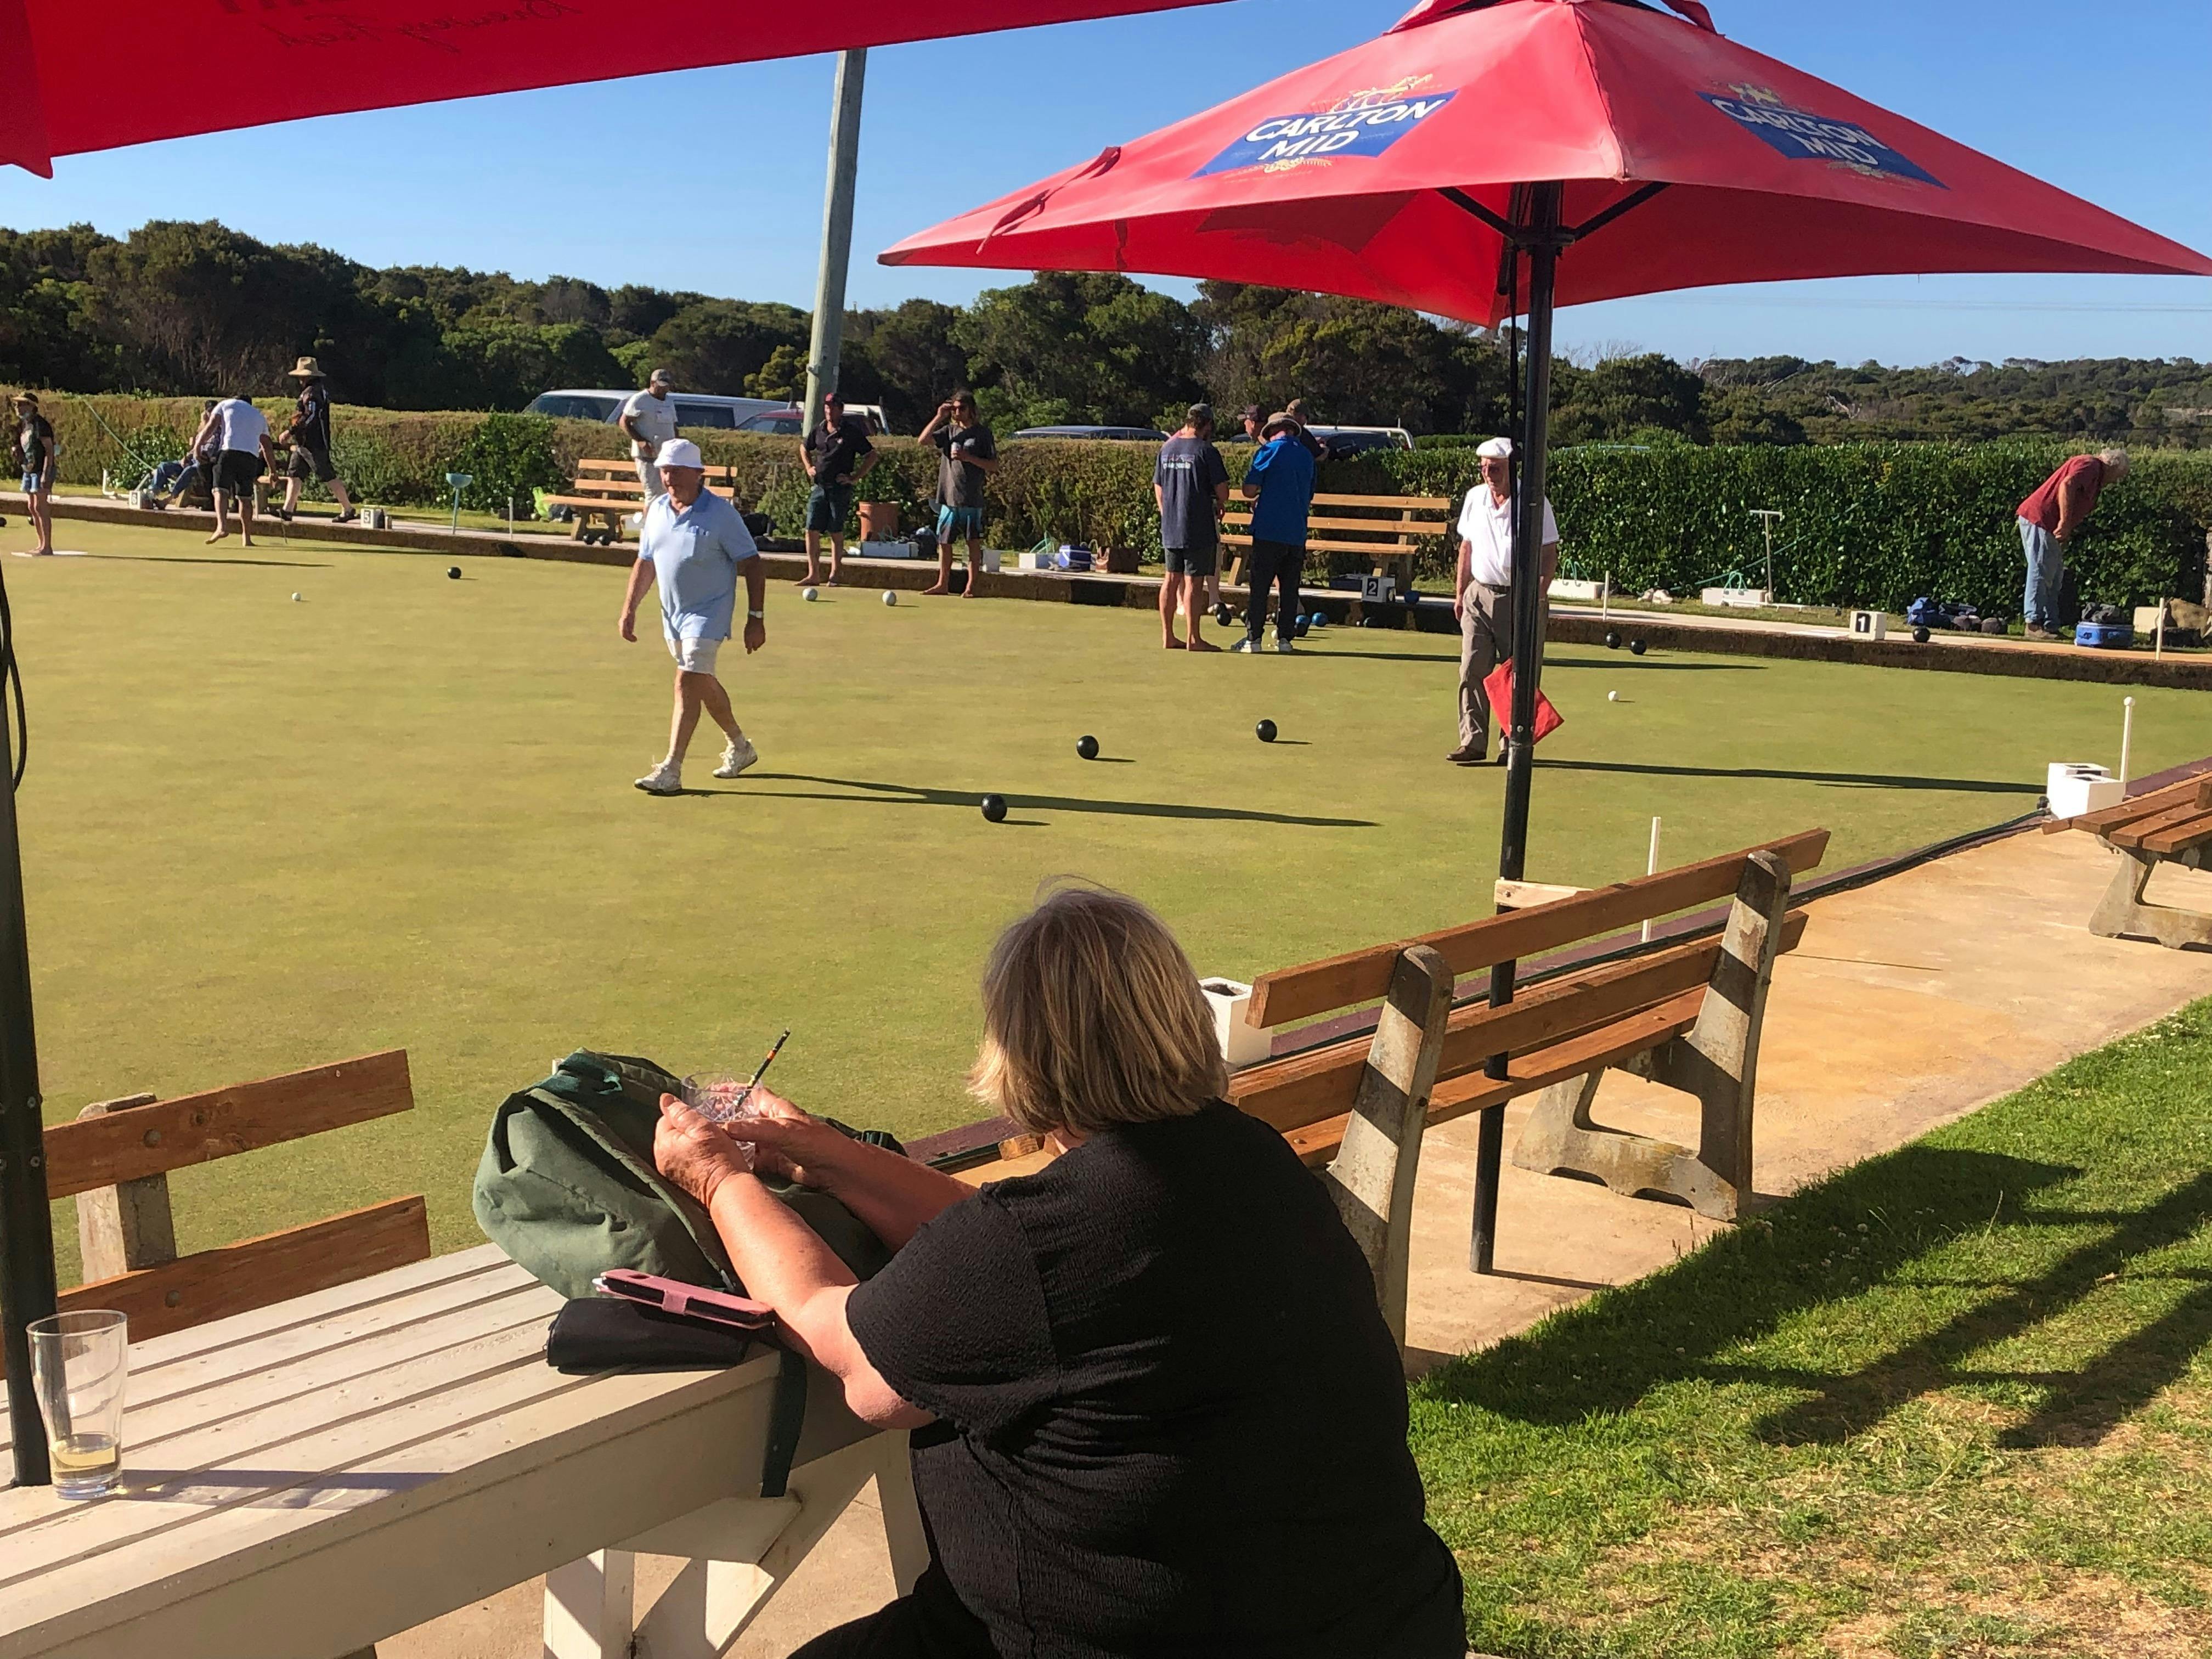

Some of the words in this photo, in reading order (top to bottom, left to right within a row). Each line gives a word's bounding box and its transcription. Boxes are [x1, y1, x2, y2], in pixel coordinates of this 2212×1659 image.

[1247, 99, 1446, 142] CARLTON
[1712, 99, 1889, 150] CARLTON
[1257, 131, 1359, 160] MID
[1785, 132, 1878, 165] MID
[364, 511, 370, 523] 5
[1368, 581, 1377, 595] 2
[1858, 616, 1866, 631] 1
